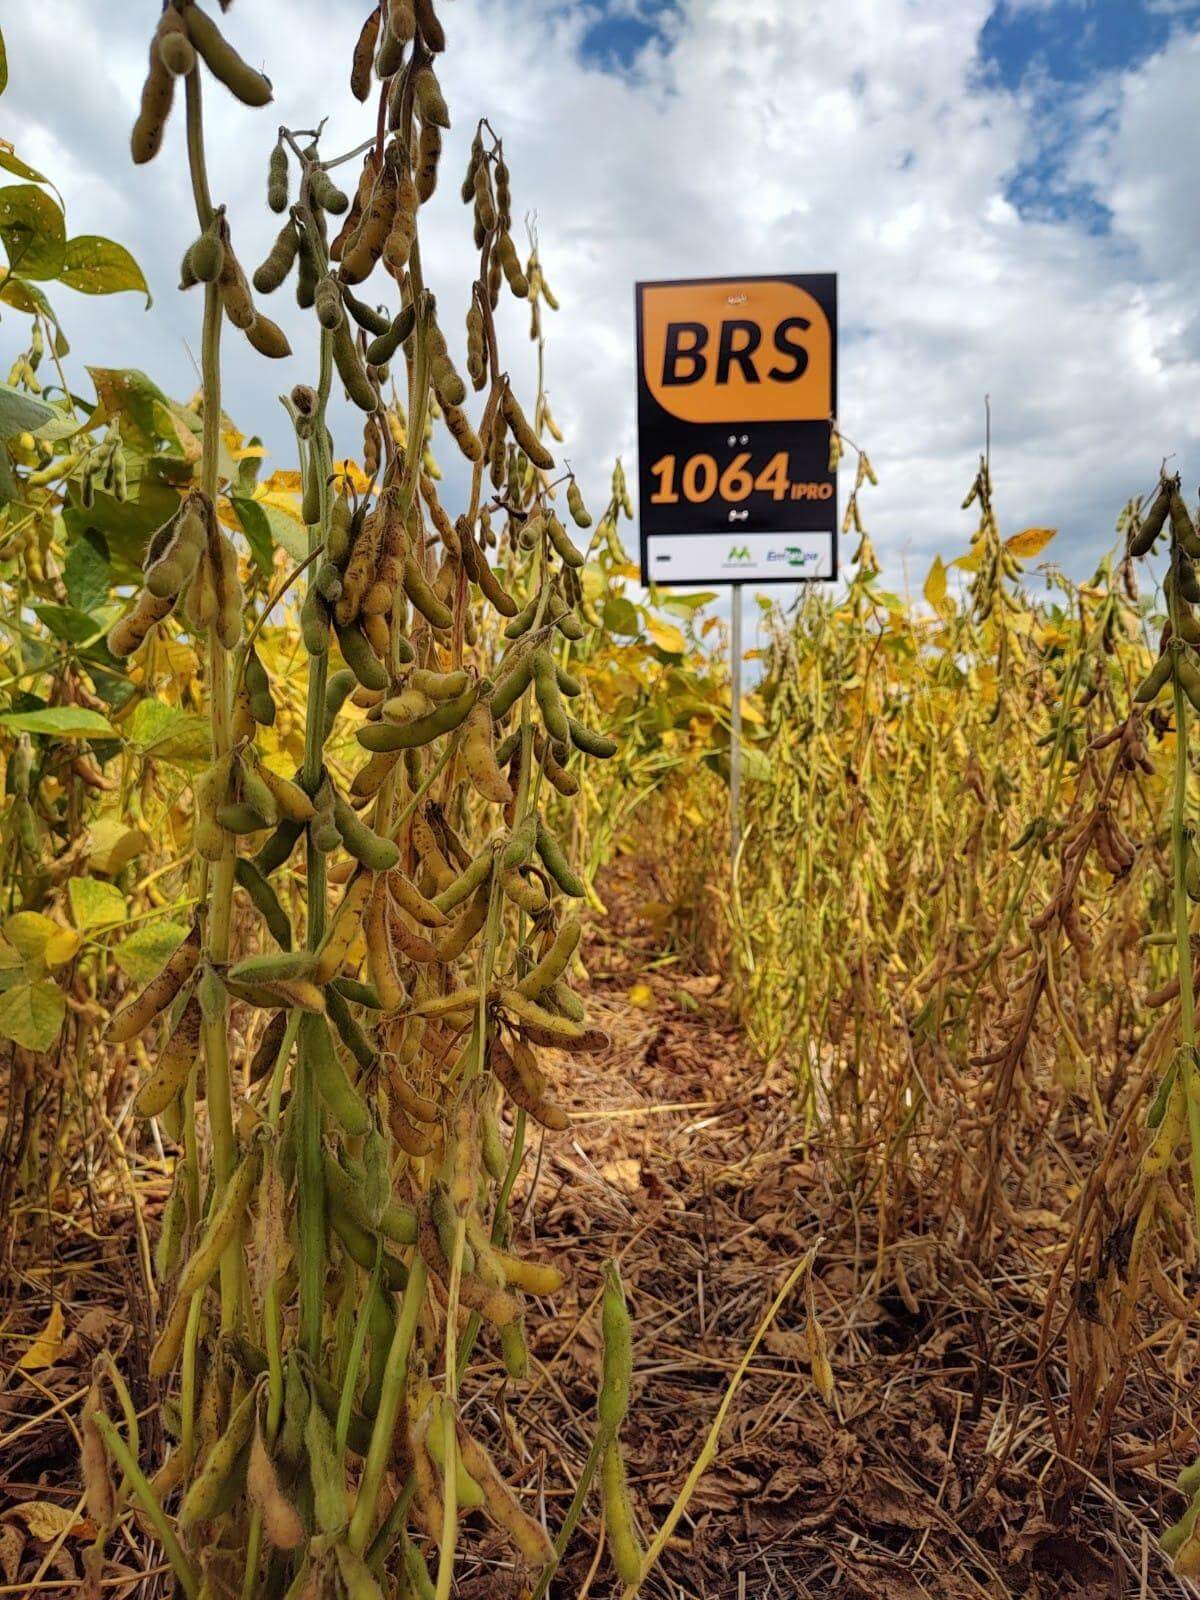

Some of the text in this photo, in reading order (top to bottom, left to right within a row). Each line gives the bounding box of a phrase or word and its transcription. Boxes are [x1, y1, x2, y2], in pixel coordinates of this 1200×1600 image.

[661, 316, 812, 387] BRS
[650, 451, 833, 504] 1064 IPRO
